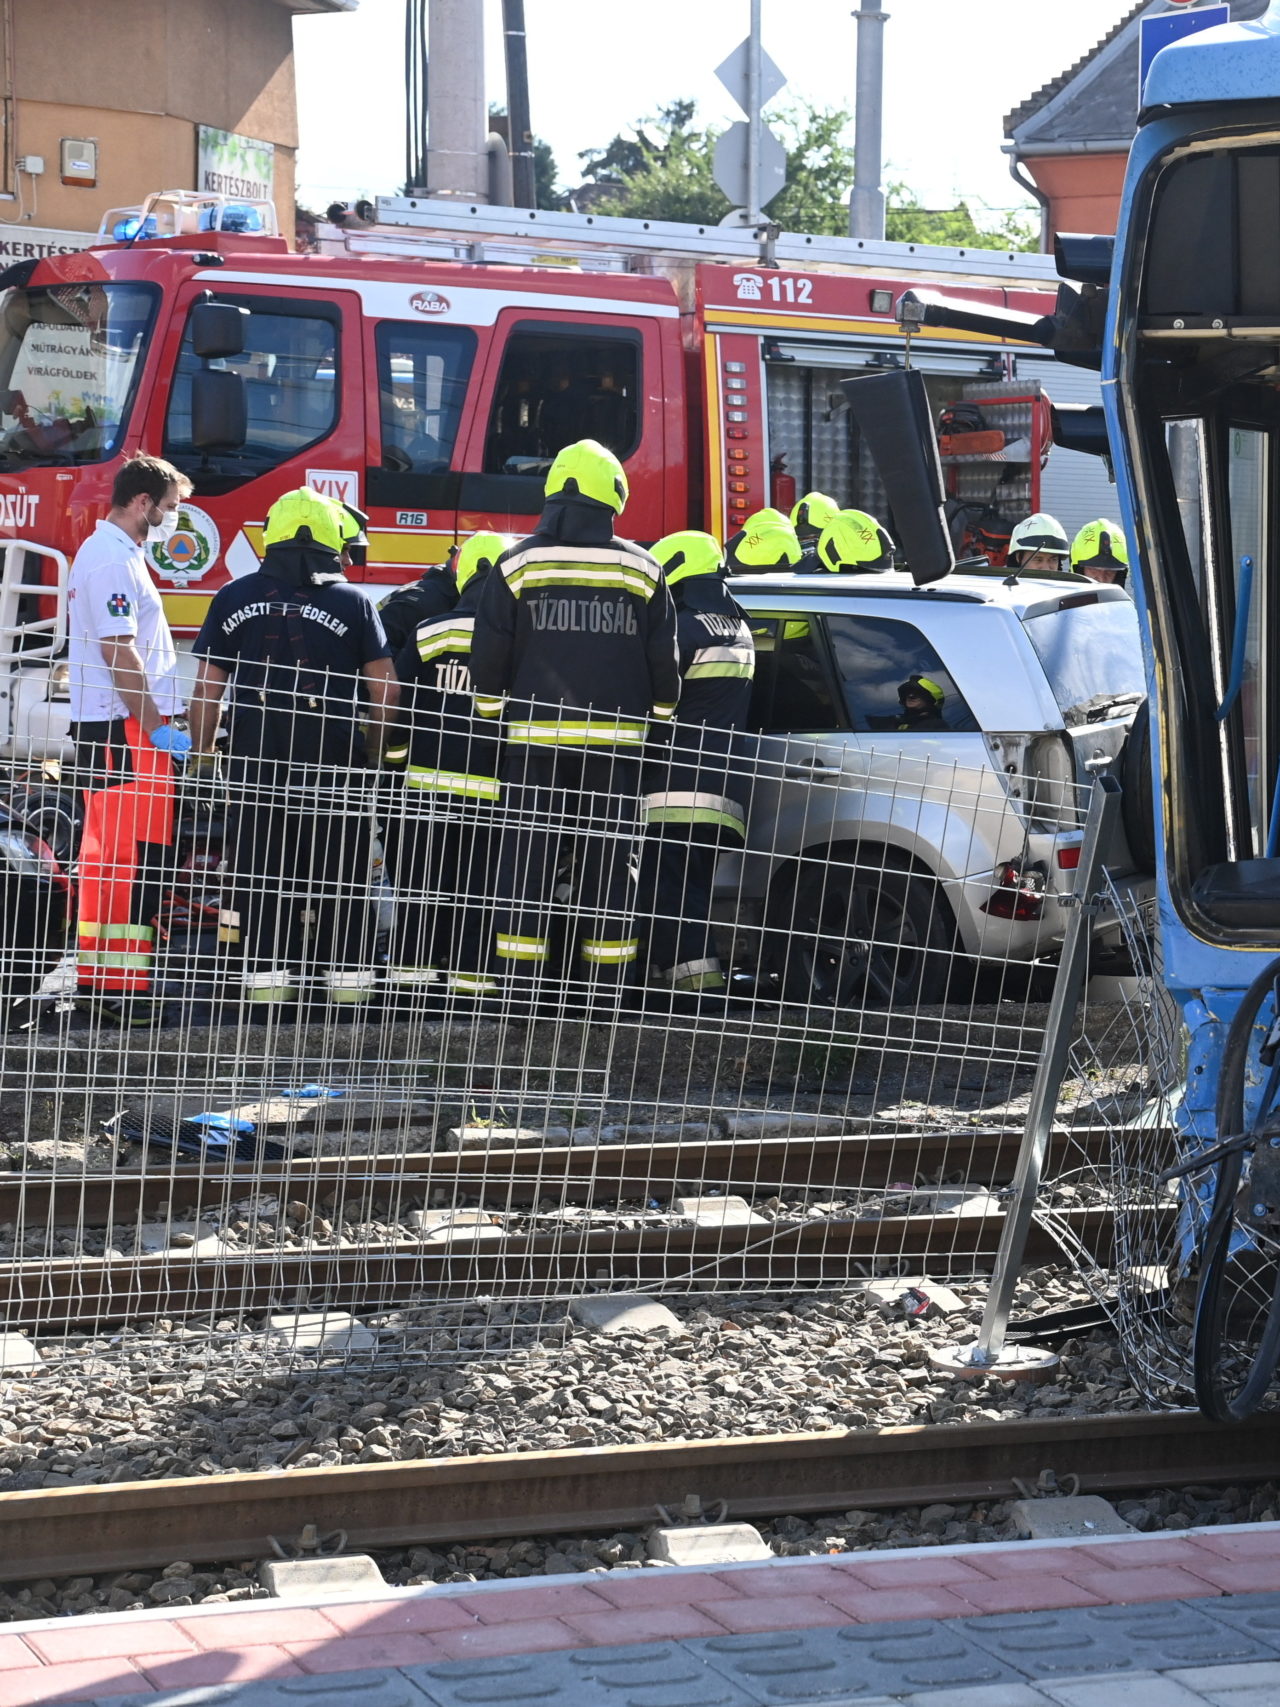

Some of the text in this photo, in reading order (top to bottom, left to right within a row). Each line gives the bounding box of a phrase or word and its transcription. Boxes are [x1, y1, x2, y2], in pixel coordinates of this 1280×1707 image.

[767, 277, 813, 304] 112
[527, 592, 637, 635] TŰZOLTÓSÁG
[435, 658, 471, 695] TŰZ
